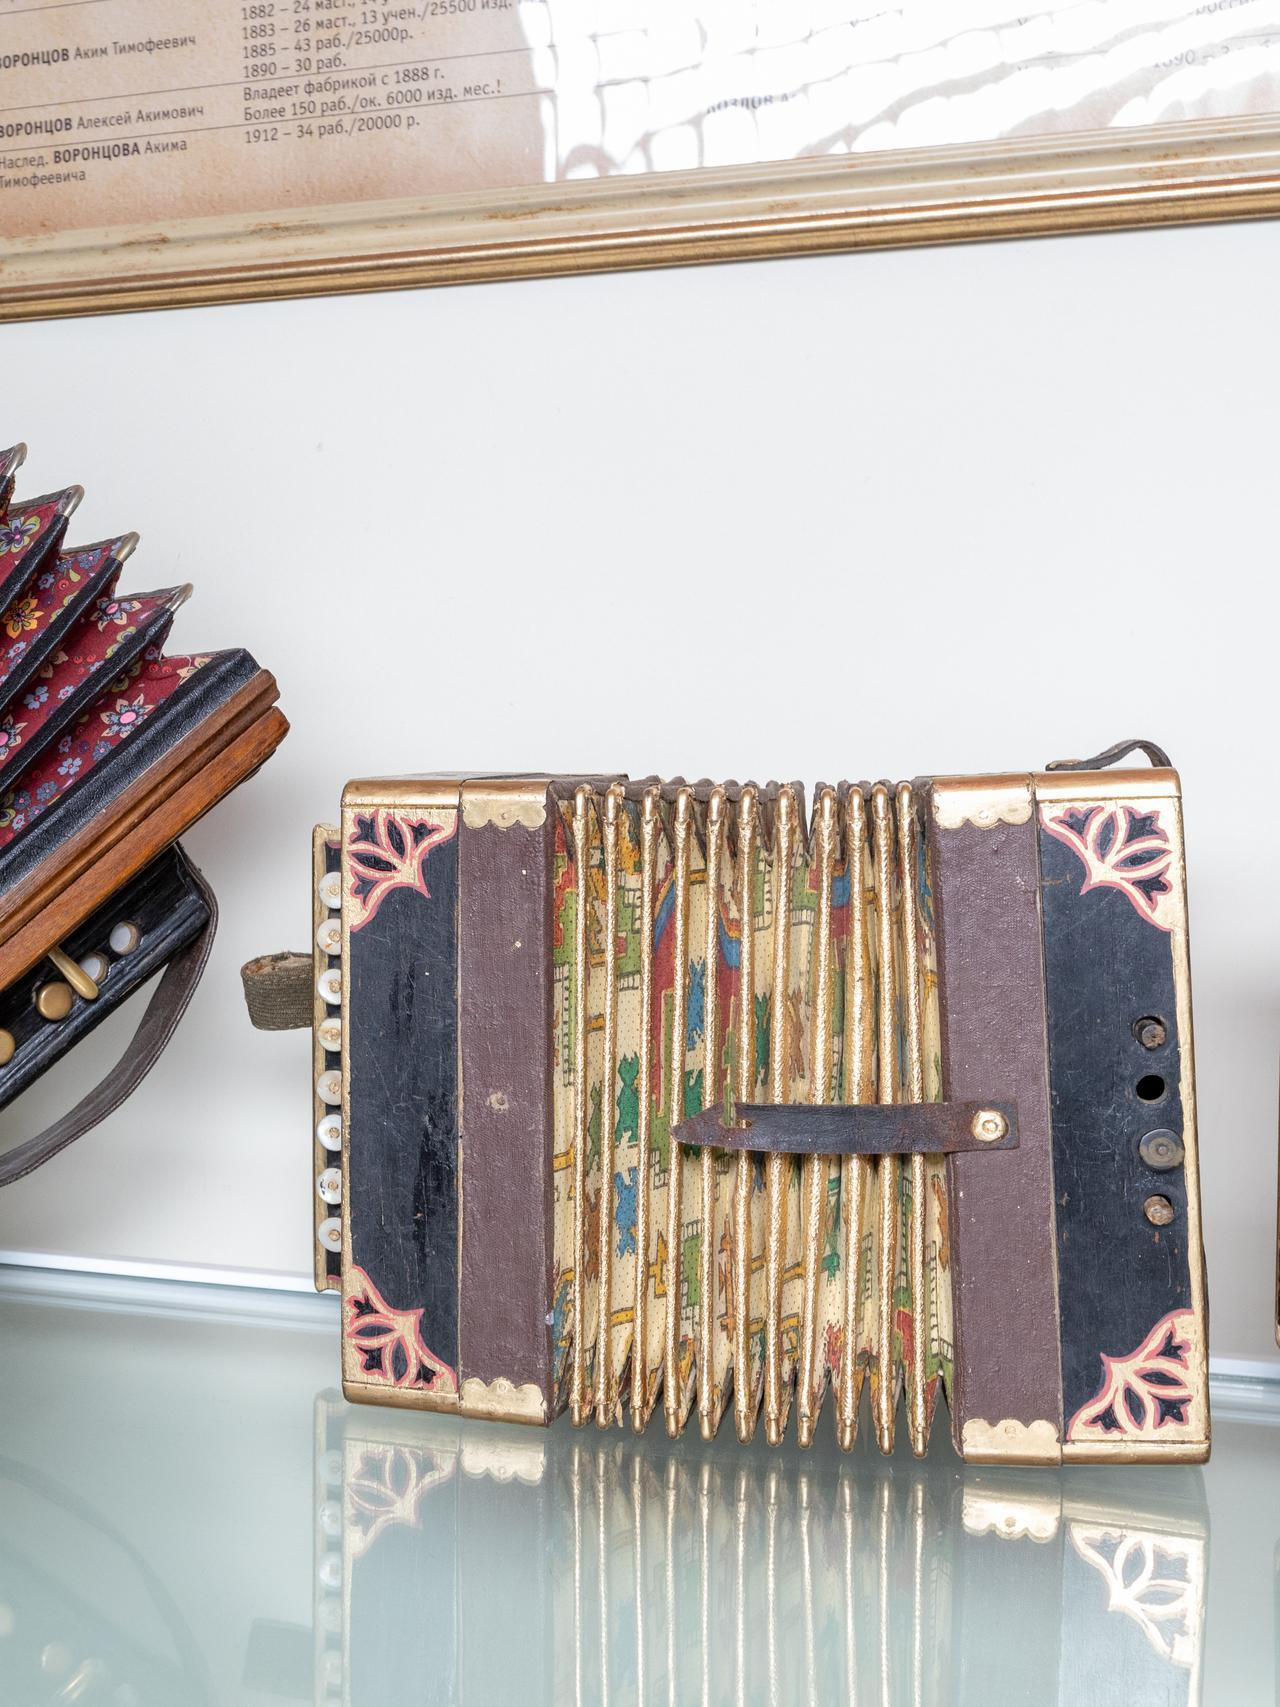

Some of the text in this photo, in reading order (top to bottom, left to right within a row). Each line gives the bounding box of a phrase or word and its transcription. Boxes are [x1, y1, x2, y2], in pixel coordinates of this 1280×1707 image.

[241, 3, 275, 20] 1882
[293, 0, 310, 14] 24
[242, 23, 276, 40] 1883
[294, 18, 311, 33] 26
[361, 9, 378, 25] 13
[74, 43, 109, 60] Аким
[112, 35, 197, 56] Тимофеевич
[242, 42, 276, 59] 1885
[294, 38, 311, 52] 43
[243, 62, 277, 78] 1890
[295, 57, 312, 73] 30
[316, 52, 347, 73] раб.
[243, 67, 445, 101] Владеет фабрикой с 1888 г.
[244, 106, 286, 121] Более
[292, 100, 316, 116] 150
[386, 88, 423, 105] 6000
[427, 88, 458, 101] изд.
[76, 111, 132, 130] Алексей
[136, 105, 204, 124] Акимович
[245, 127, 279, 144] 1912
[297, 123, 313, 139] 34
[407, 115, 420, 130] р.
[53, 142, 141, 164] ВОРОНЦОВА
[144, 139, 187, 154] Акима
[0, 170, 86, 189] Тимофеевича
